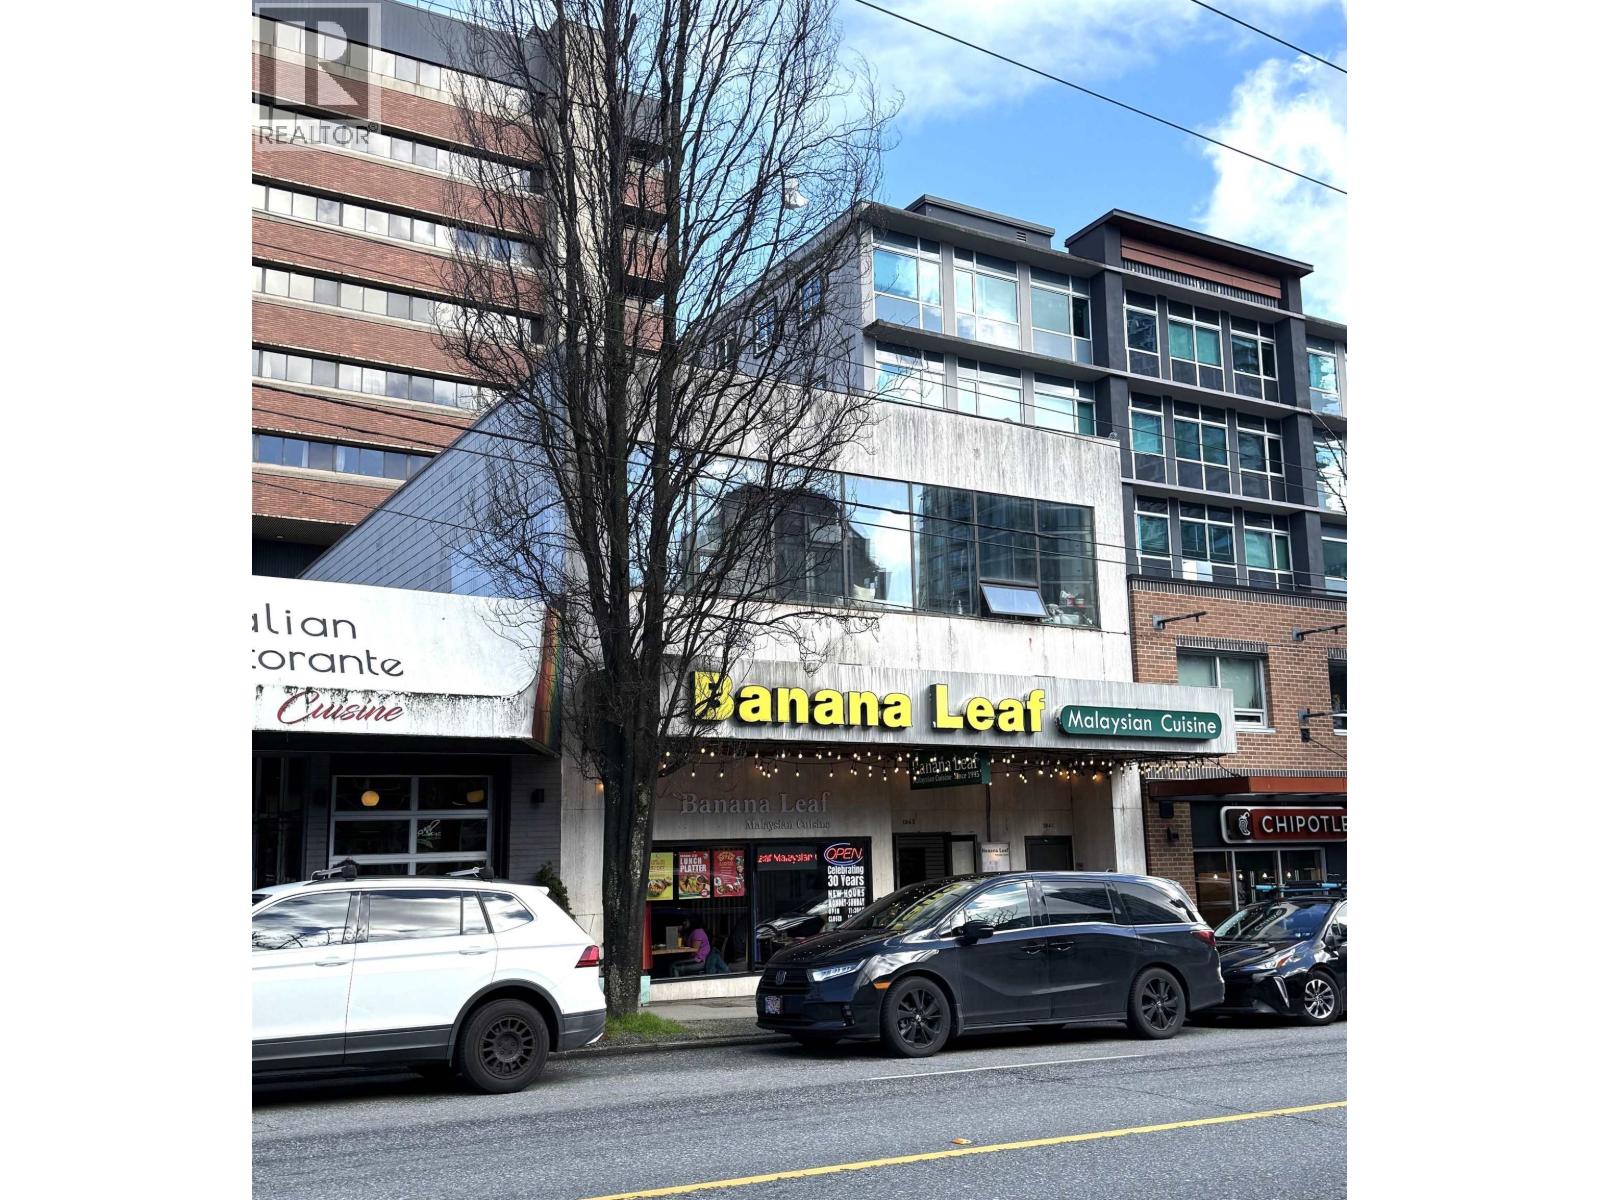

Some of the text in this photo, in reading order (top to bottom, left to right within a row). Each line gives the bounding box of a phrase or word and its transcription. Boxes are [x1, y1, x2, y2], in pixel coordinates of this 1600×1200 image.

[252, 649, 404, 677] orante
[277, 690, 404, 725] Cuisine
[692, 671, 1046, 733] Banana Leaf
[1068, 710, 1217, 735] Malaysian Cuisine
[681, 792, 831, 815] Banana Leaf
[680, 857, 702, 865] LUNCH
[826, 848, 863, 860] OPEN
[680, 864, 707, 873] PLATTER
[827, 865, 865, 875] Celebrating
[828, 875, 865, 887] 30 Years
